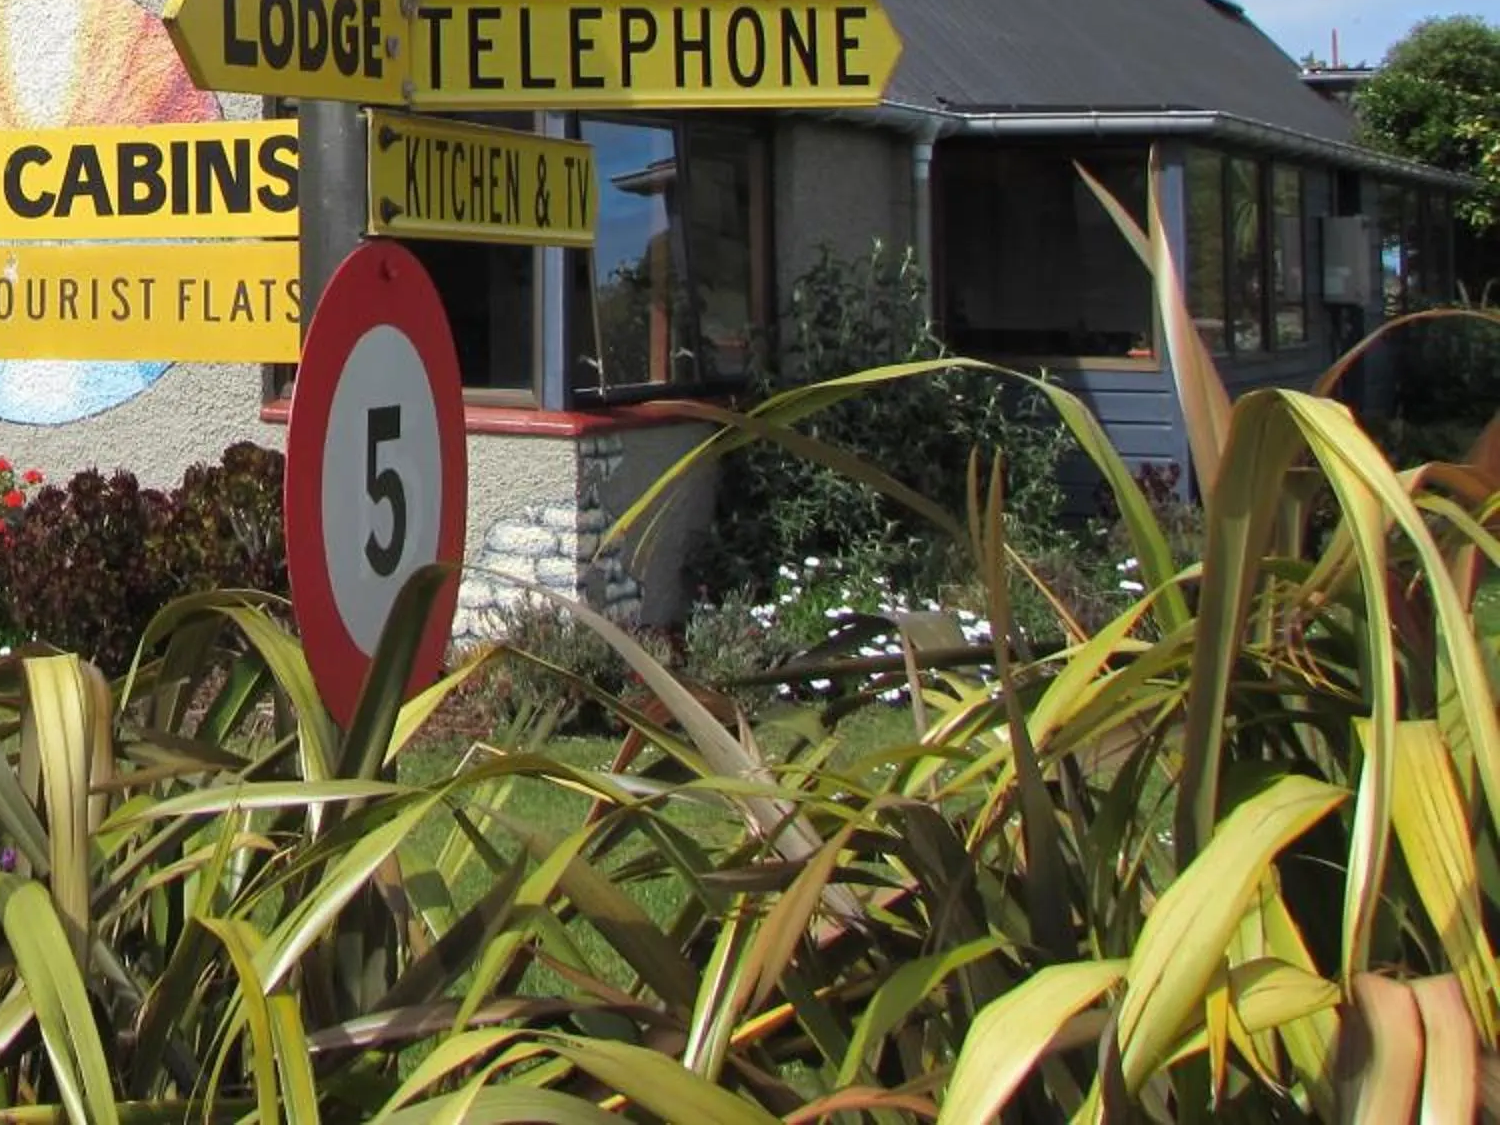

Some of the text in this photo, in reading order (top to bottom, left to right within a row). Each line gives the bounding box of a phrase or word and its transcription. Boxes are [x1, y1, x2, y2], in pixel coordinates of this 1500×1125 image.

[418, 6, 871, 90] TELEPHONE
[3, 134, 300, 219] CABINS
[405, 135, 589, 229] KITCHEN & TV
[178, 277, 302, 323] FLATS
[363, 404, 407, 578] 5
